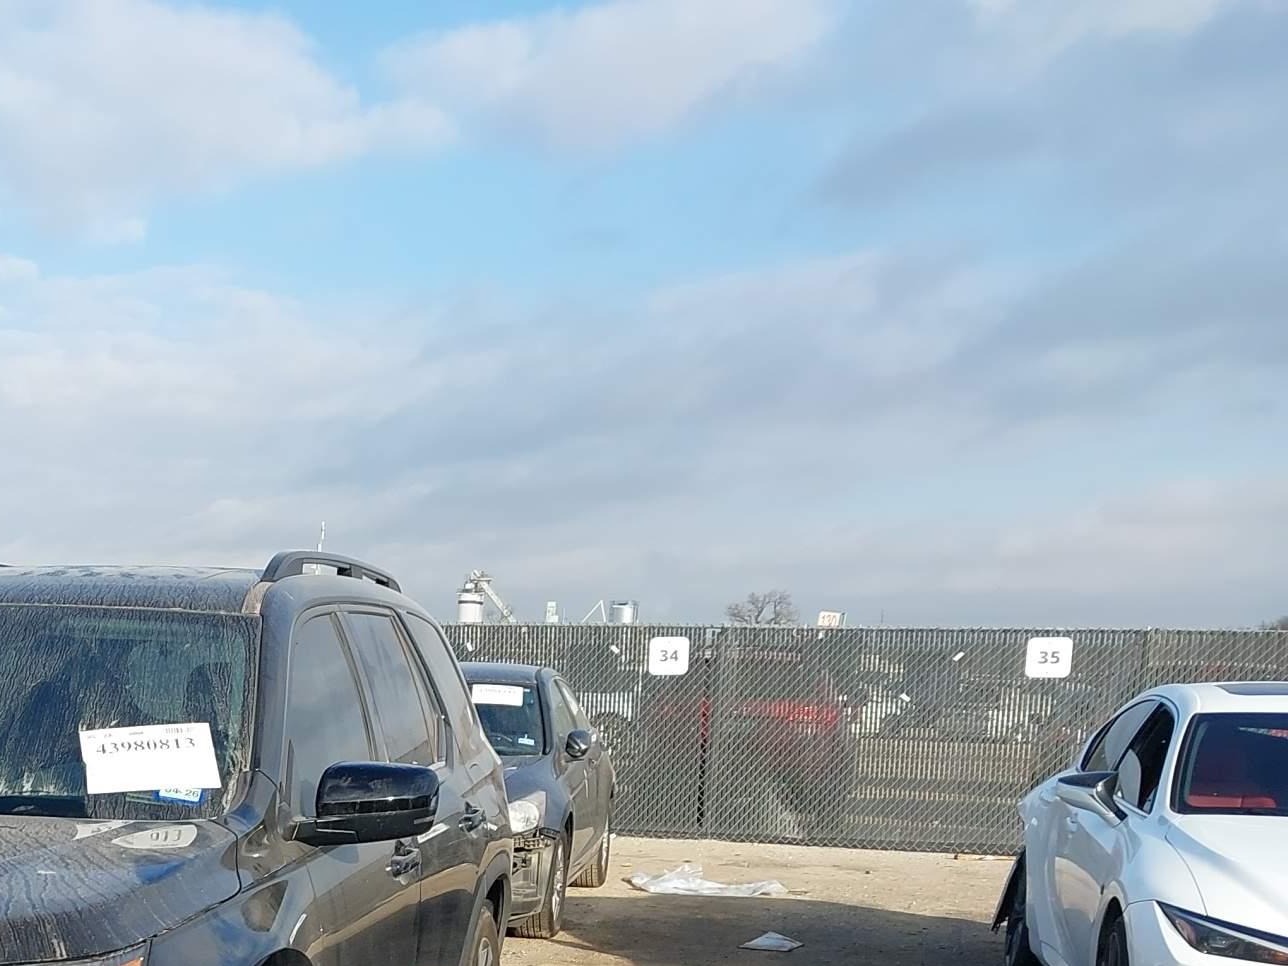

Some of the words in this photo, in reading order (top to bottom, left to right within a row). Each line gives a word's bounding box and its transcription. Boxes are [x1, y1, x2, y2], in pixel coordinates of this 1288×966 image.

[659, 649, 679, 662] 34
[1037, 651, 1061, 664] 35
[96, 737, 197, 755] 43980813
